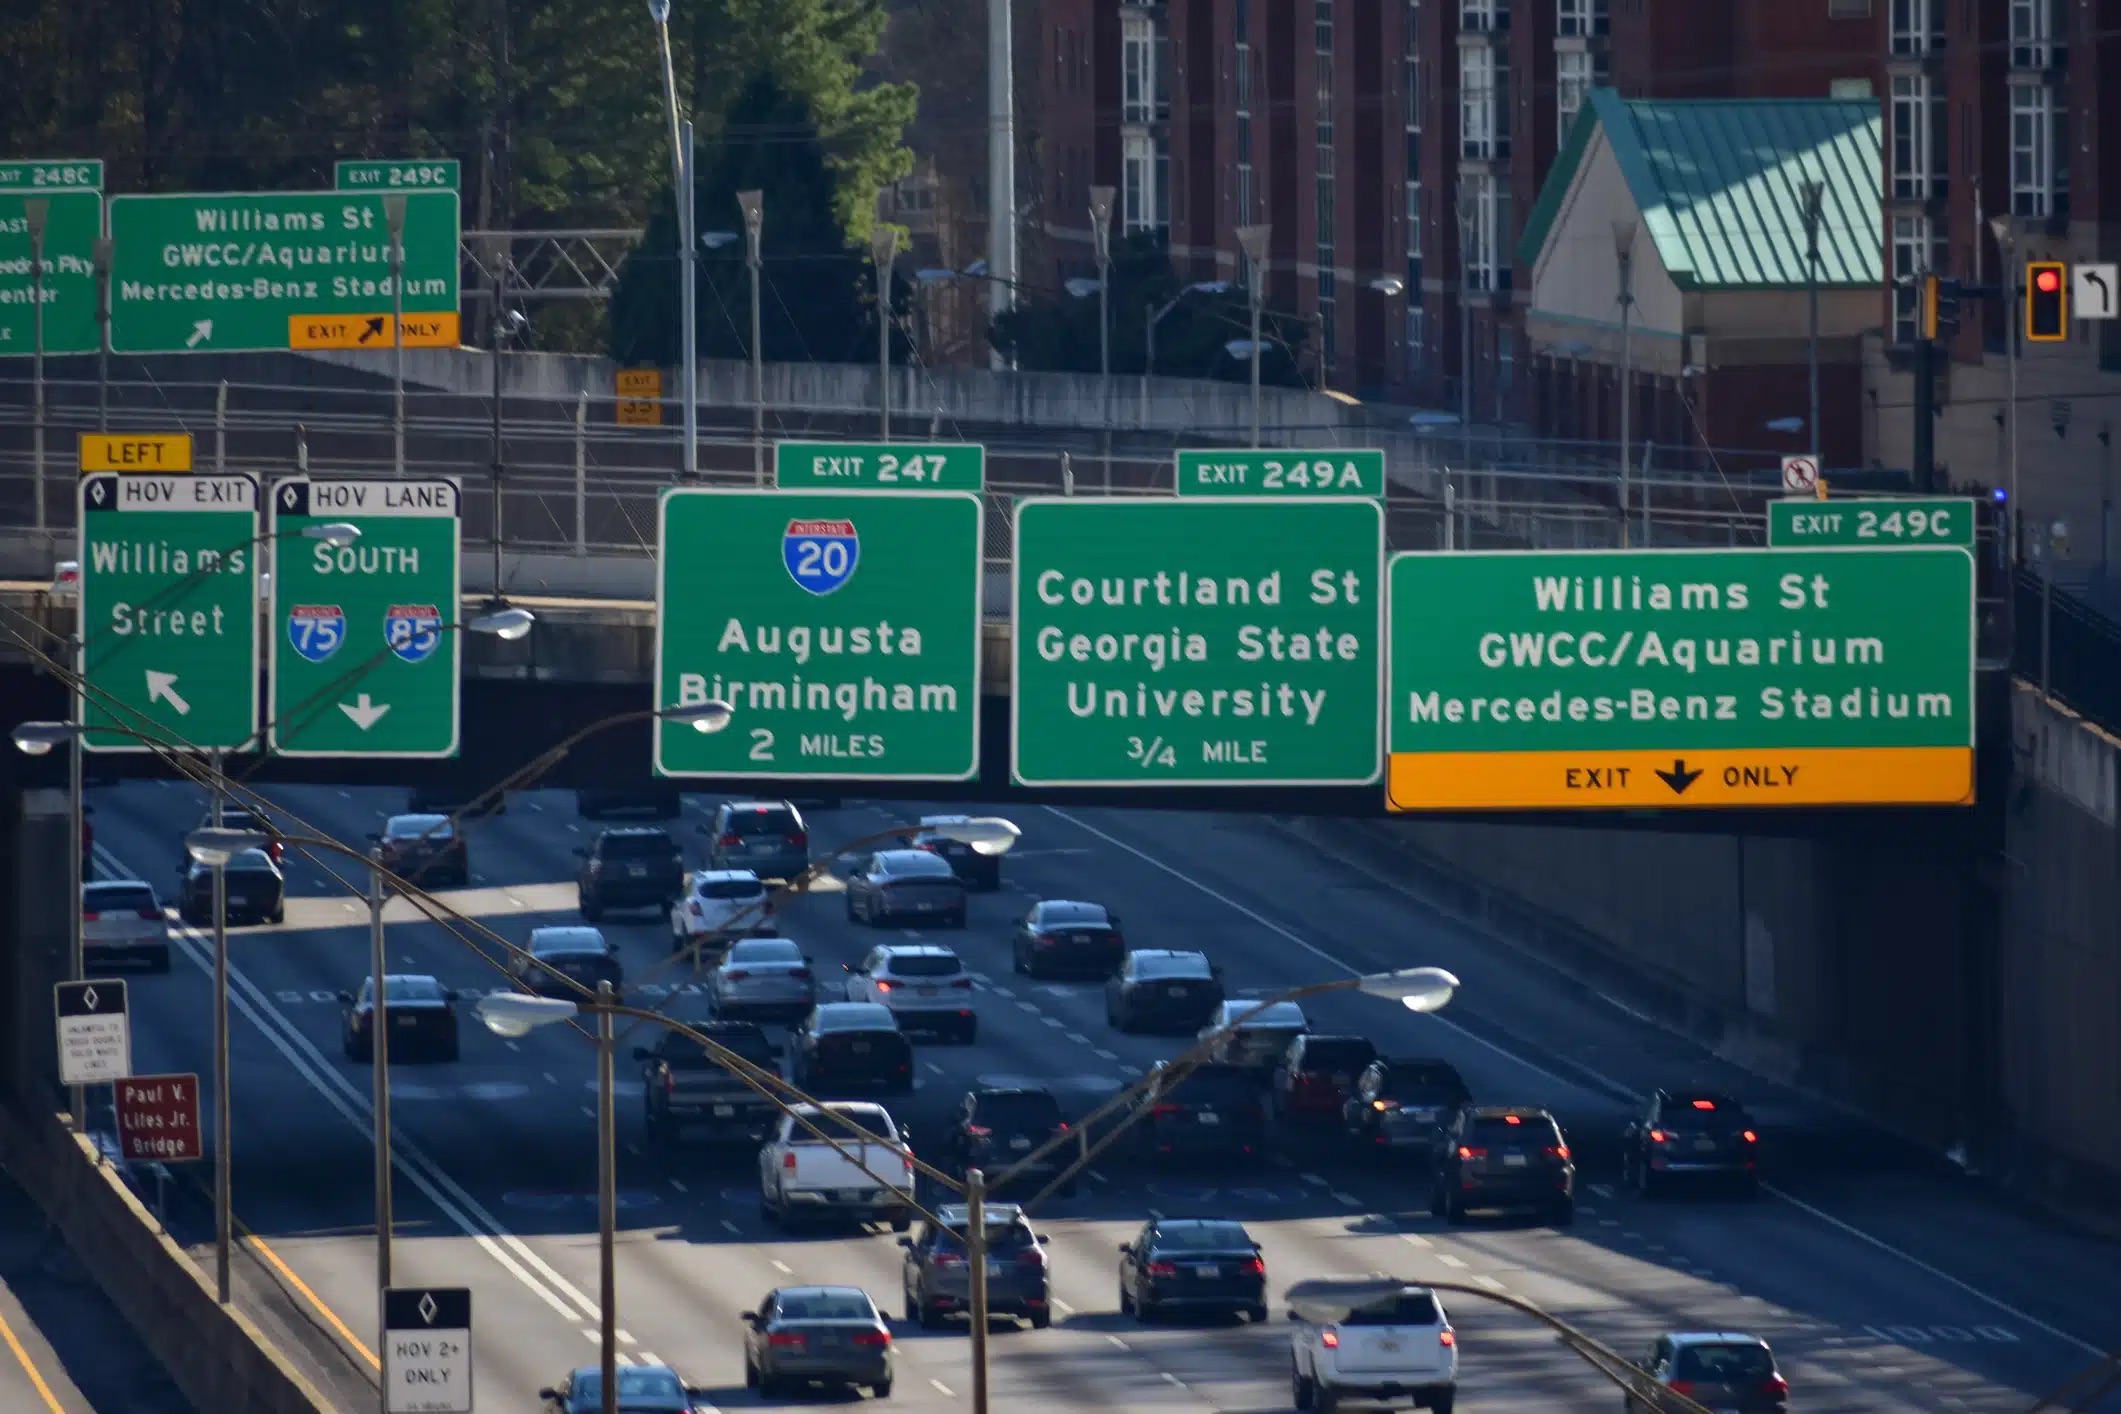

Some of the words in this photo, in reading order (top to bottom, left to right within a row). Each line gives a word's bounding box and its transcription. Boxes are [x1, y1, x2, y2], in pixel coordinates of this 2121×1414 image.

[32, 166, 90, 185] 248C
[349, 170, 381, 183] EXIT
[388, 167, 446, 185] 249C
[195, 207, 325, 232] Williams
[342, 205, 374, 230] St
[121, 277, 318, 301] Mercedes-Benz
[307, 323, 347, 339] EXIT
[107, 443, 165, 463] LEFT
[813, 457, 864, 476] EXIT
[877, 456, 947, 482] 247
[1197, 464, 1248, 484] EXIT
[1262, 462, 1363, 489] 249A
[126, 481, 176, 502] HOV
[195, 481, 246, 502] EXIT
[316, 485, 368, 507] HOV
[385, 486, 449, 508] LANE
[1791, 513, 1844, 536] EXIT
[1857, 511, 1952, 538] 249C
[91, 541, 246, 574] Williams
[312, 541, 419, 574] SOUTH
[797, 541, 848, 577] 20
[1037, 570, 1281, 606] Courtland
[1310, 570, 1361, 605] St
[1533, 576, 1750, 612] Williams
[1779, 574, 1831, 609] St
[112, 601, 225, 636] Street
[294, 619, 339, 650] 75
[391, 619, 437, 650] 85
[717, 617, 922, 664] Augusta
[1037, 626, 1208, 672] Georgia
[1237, 625, 1360, 662] State
[1479, 630, 1884, 673] GWCC/Aquarium
[679, 672, 957, 721] Birmingham
[1067, 681, 1327, 726] University
[1409, 690, 1738, 724] Mercedes-Benz
[1760, 688, 1953, 720] Stadium
[748, 728, 775, 760] 2
[800, 734, 885, 757] MILES
[1127, 736, 1178, 768] 3/4
[1202, 740, 1268, 763] MILE
[1566, 768, 1632, 789] EXIT
[1723, 766, 1800, 788] ONLY
[126, 1085, 163, 1104] Paul
[172, 1084, 187, 1102] V.
[169, 1111, 190, 1128] Jr.
[133, 1137, 186, 1156] Bridge
[397, 1342, 431, 1358] HOV
[406, 1367, 451, 1384] ONLY
